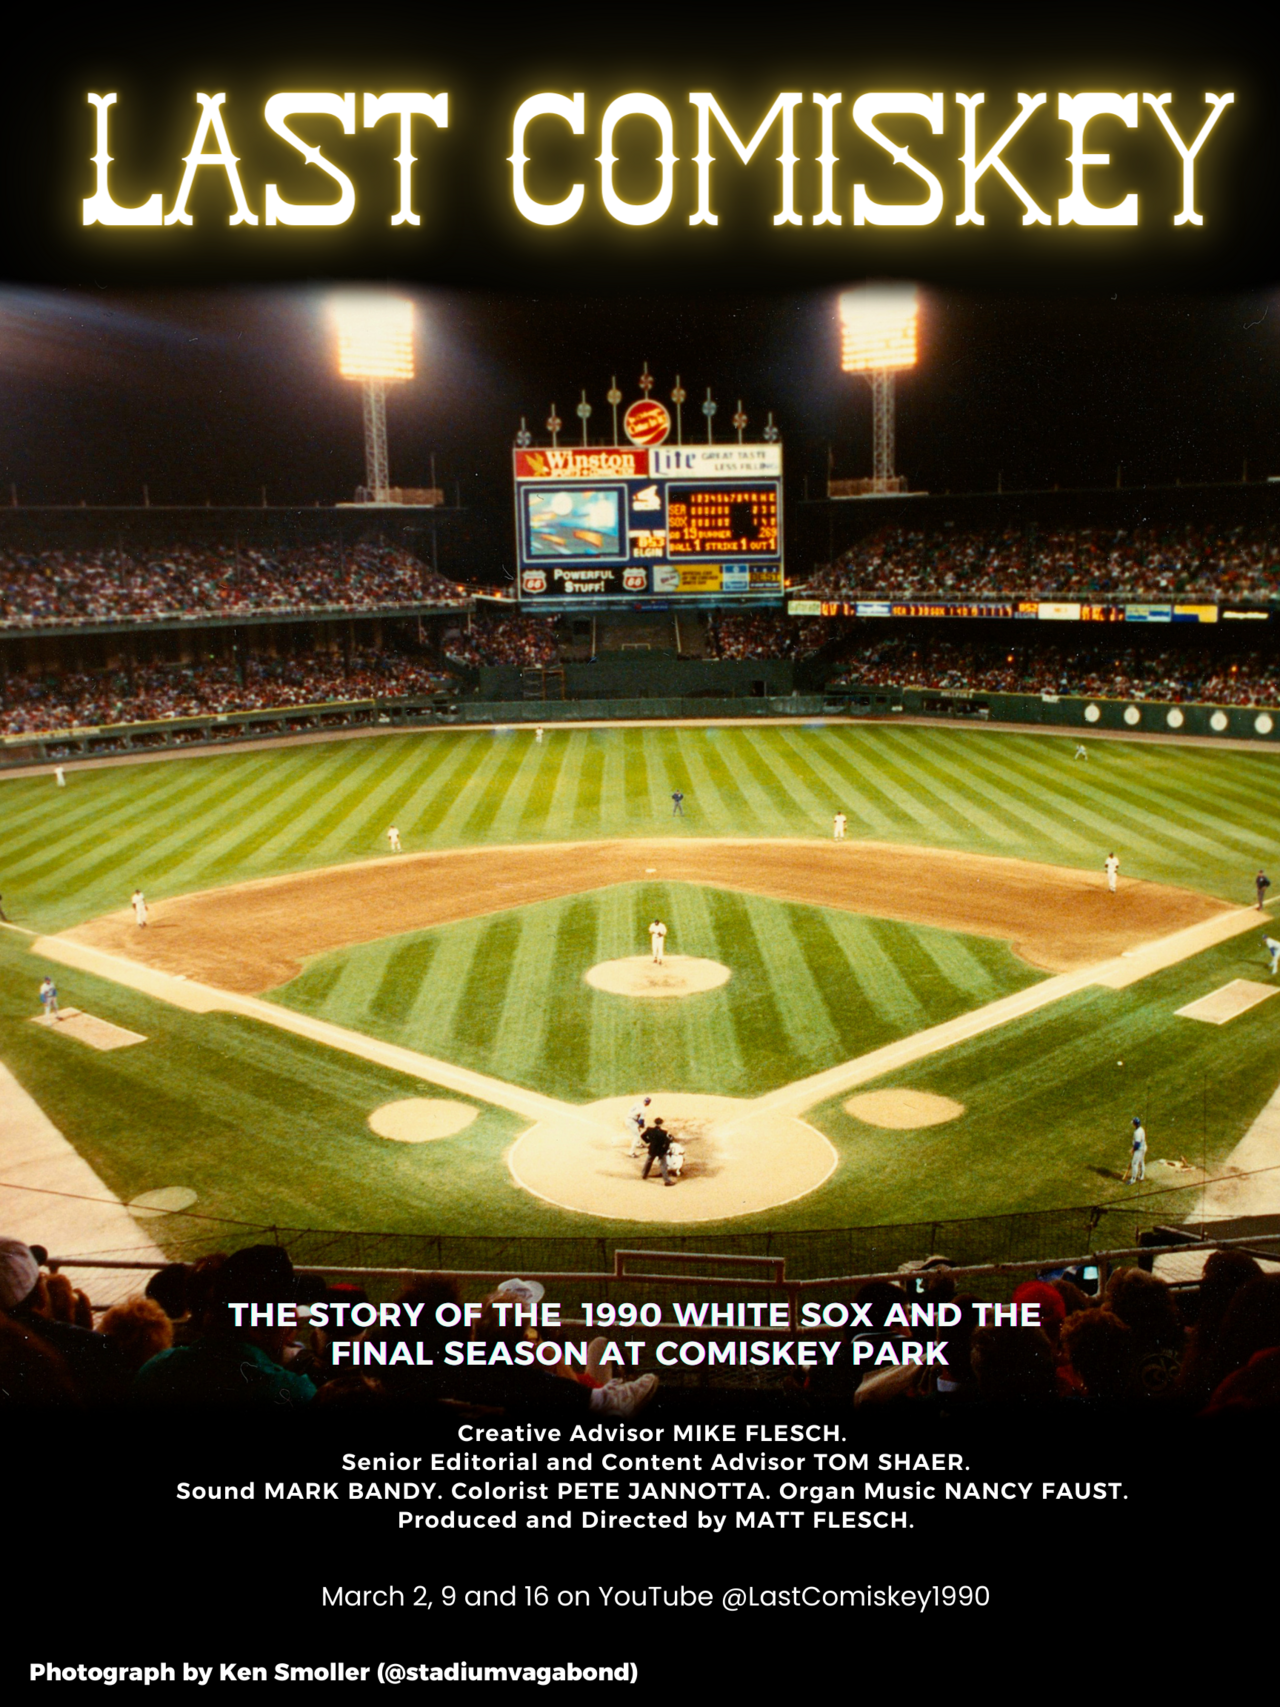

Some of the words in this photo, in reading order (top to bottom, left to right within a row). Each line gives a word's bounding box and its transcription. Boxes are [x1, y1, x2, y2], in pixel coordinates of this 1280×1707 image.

[545, 450, 636, 468] Winston
[654, 450, 696, 475] Lite
[701, 452, 733, 460] GREAT
[738, 451, 767, 460] TASTE
[715, 463, 737, 471] LESS
[669, 516, 688, 527] SOX
[683, 527, 697, 539] 19
[669, 542, 692, 551] BALL
[694, 539, 700, 551] 1
[705, 541, 738, 551] STRIKE
[741, 538, 747, 550] 1
[750, 541, 767, 550] OUT
[769, 538, 776, 550] 1
[633, 547, 663, 558] ELGIN
[527, 579, 541, 589] 66
[627, 577, 641, 587] 66
